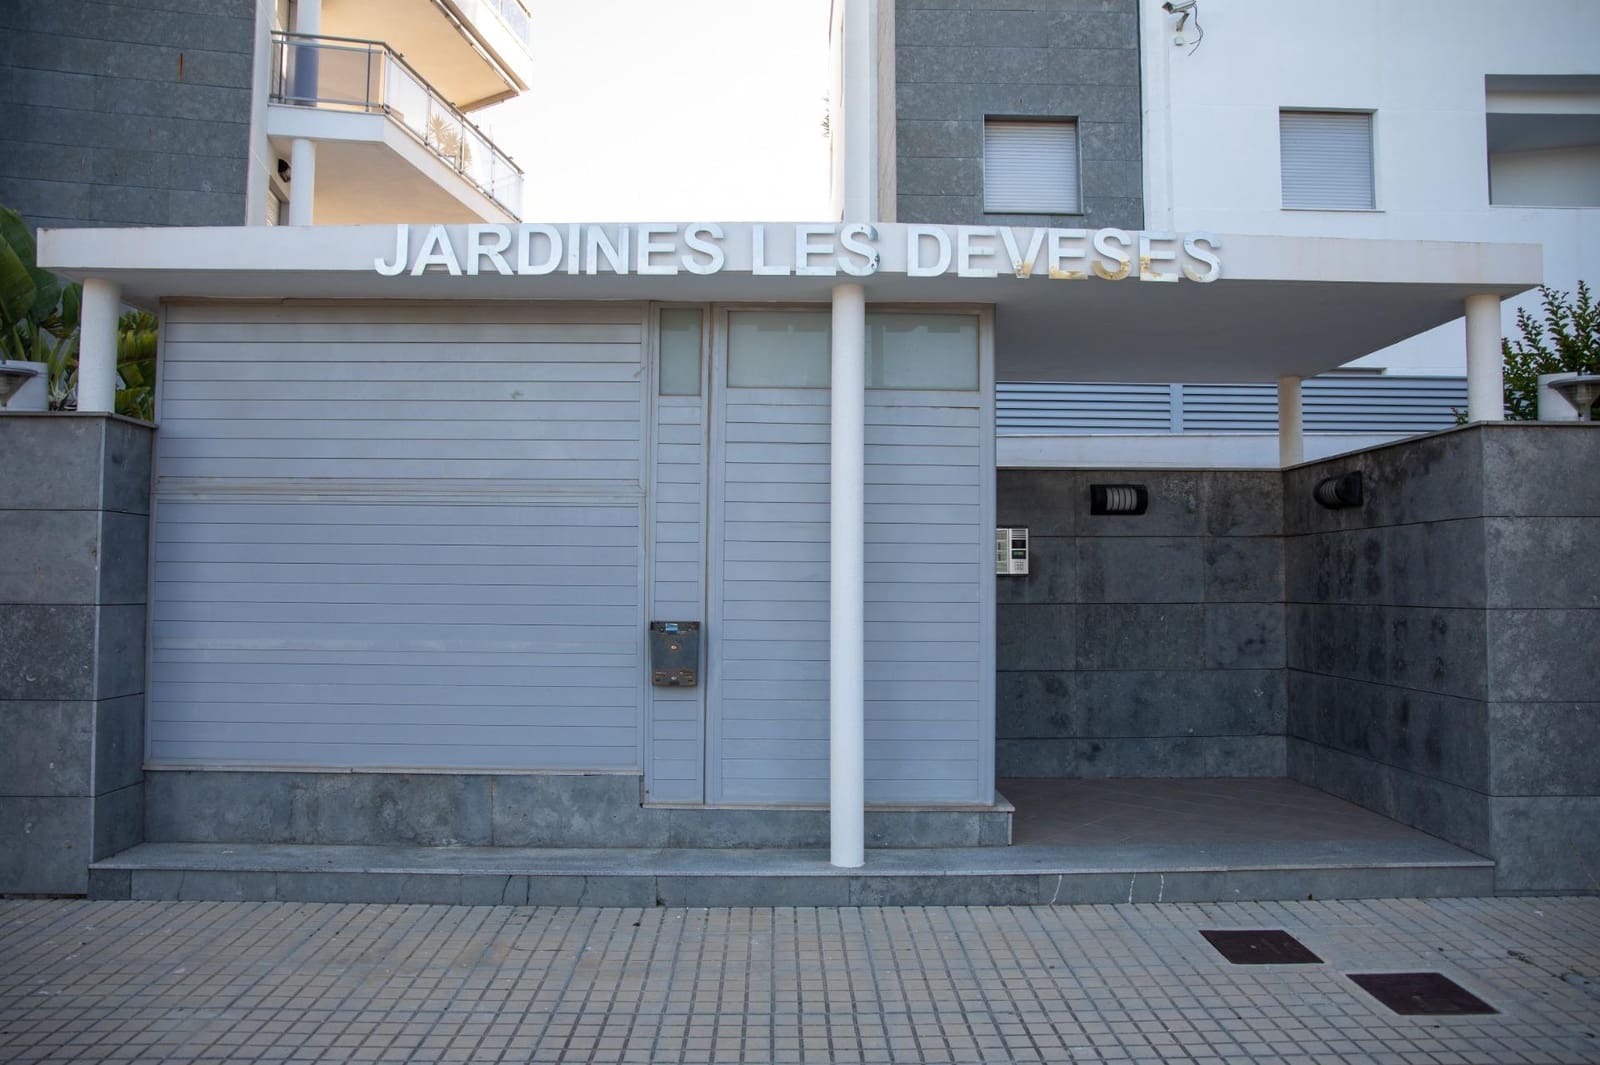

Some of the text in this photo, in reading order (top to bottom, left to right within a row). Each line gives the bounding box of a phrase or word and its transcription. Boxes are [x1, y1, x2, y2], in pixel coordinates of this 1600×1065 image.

[374, 223, 1221, 283] JARDINES LES DEVESES
